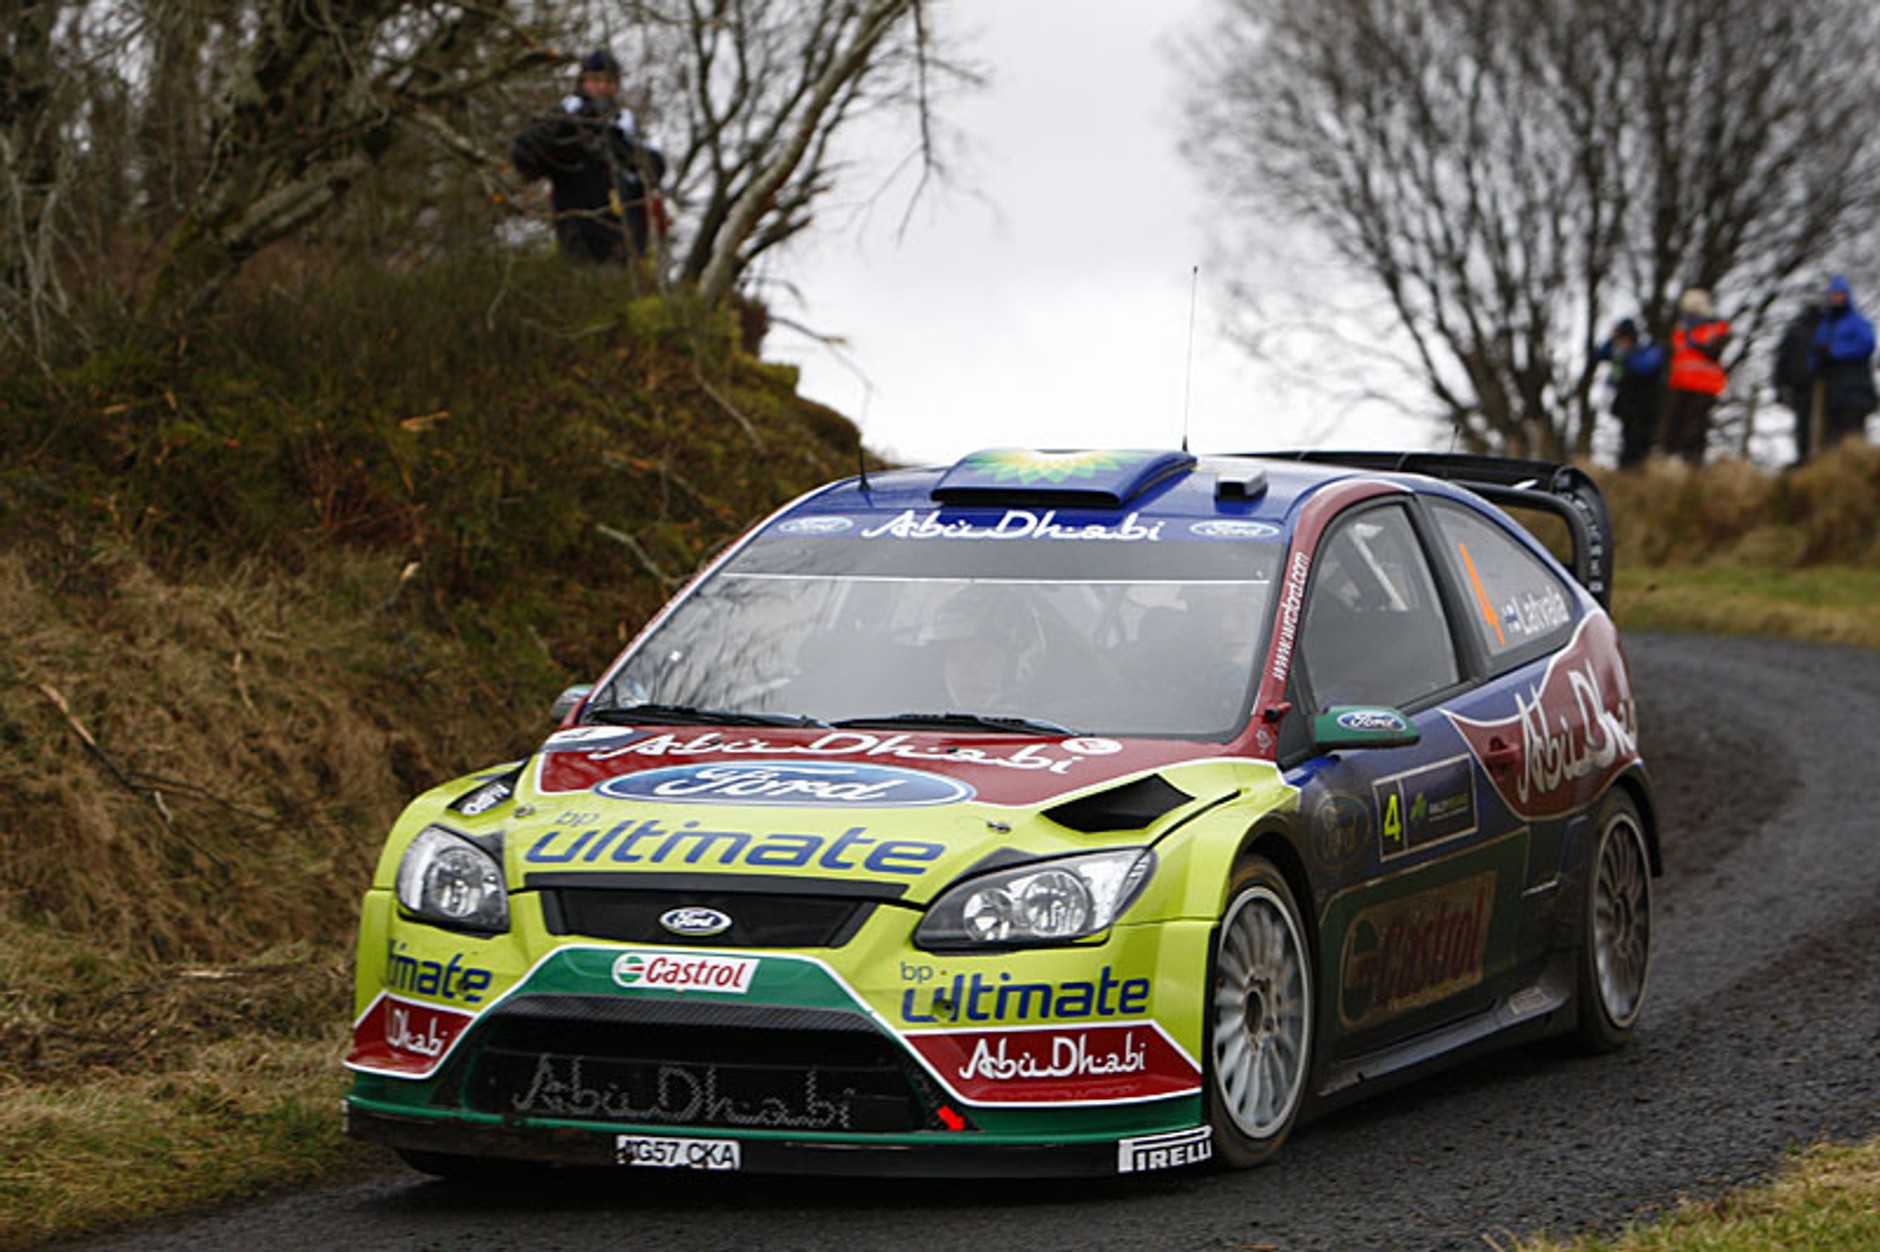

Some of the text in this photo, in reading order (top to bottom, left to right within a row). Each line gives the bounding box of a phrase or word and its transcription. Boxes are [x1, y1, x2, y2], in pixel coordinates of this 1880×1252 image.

[653, 767, 903, 801] Ford
[553, 810, 600, 828] bp
[1384, 794, 1401, 842] 4
[524, 819, 946, 876] ultimate
[645, 956, 747, 988] Castrol
[901, 962, 933, 982] bp
[903, 966, 1150, 1023] ultimate
[686, 1142, 736, 1168] CKA
[1118, 1125, 1213, 1173] PIRELLI
